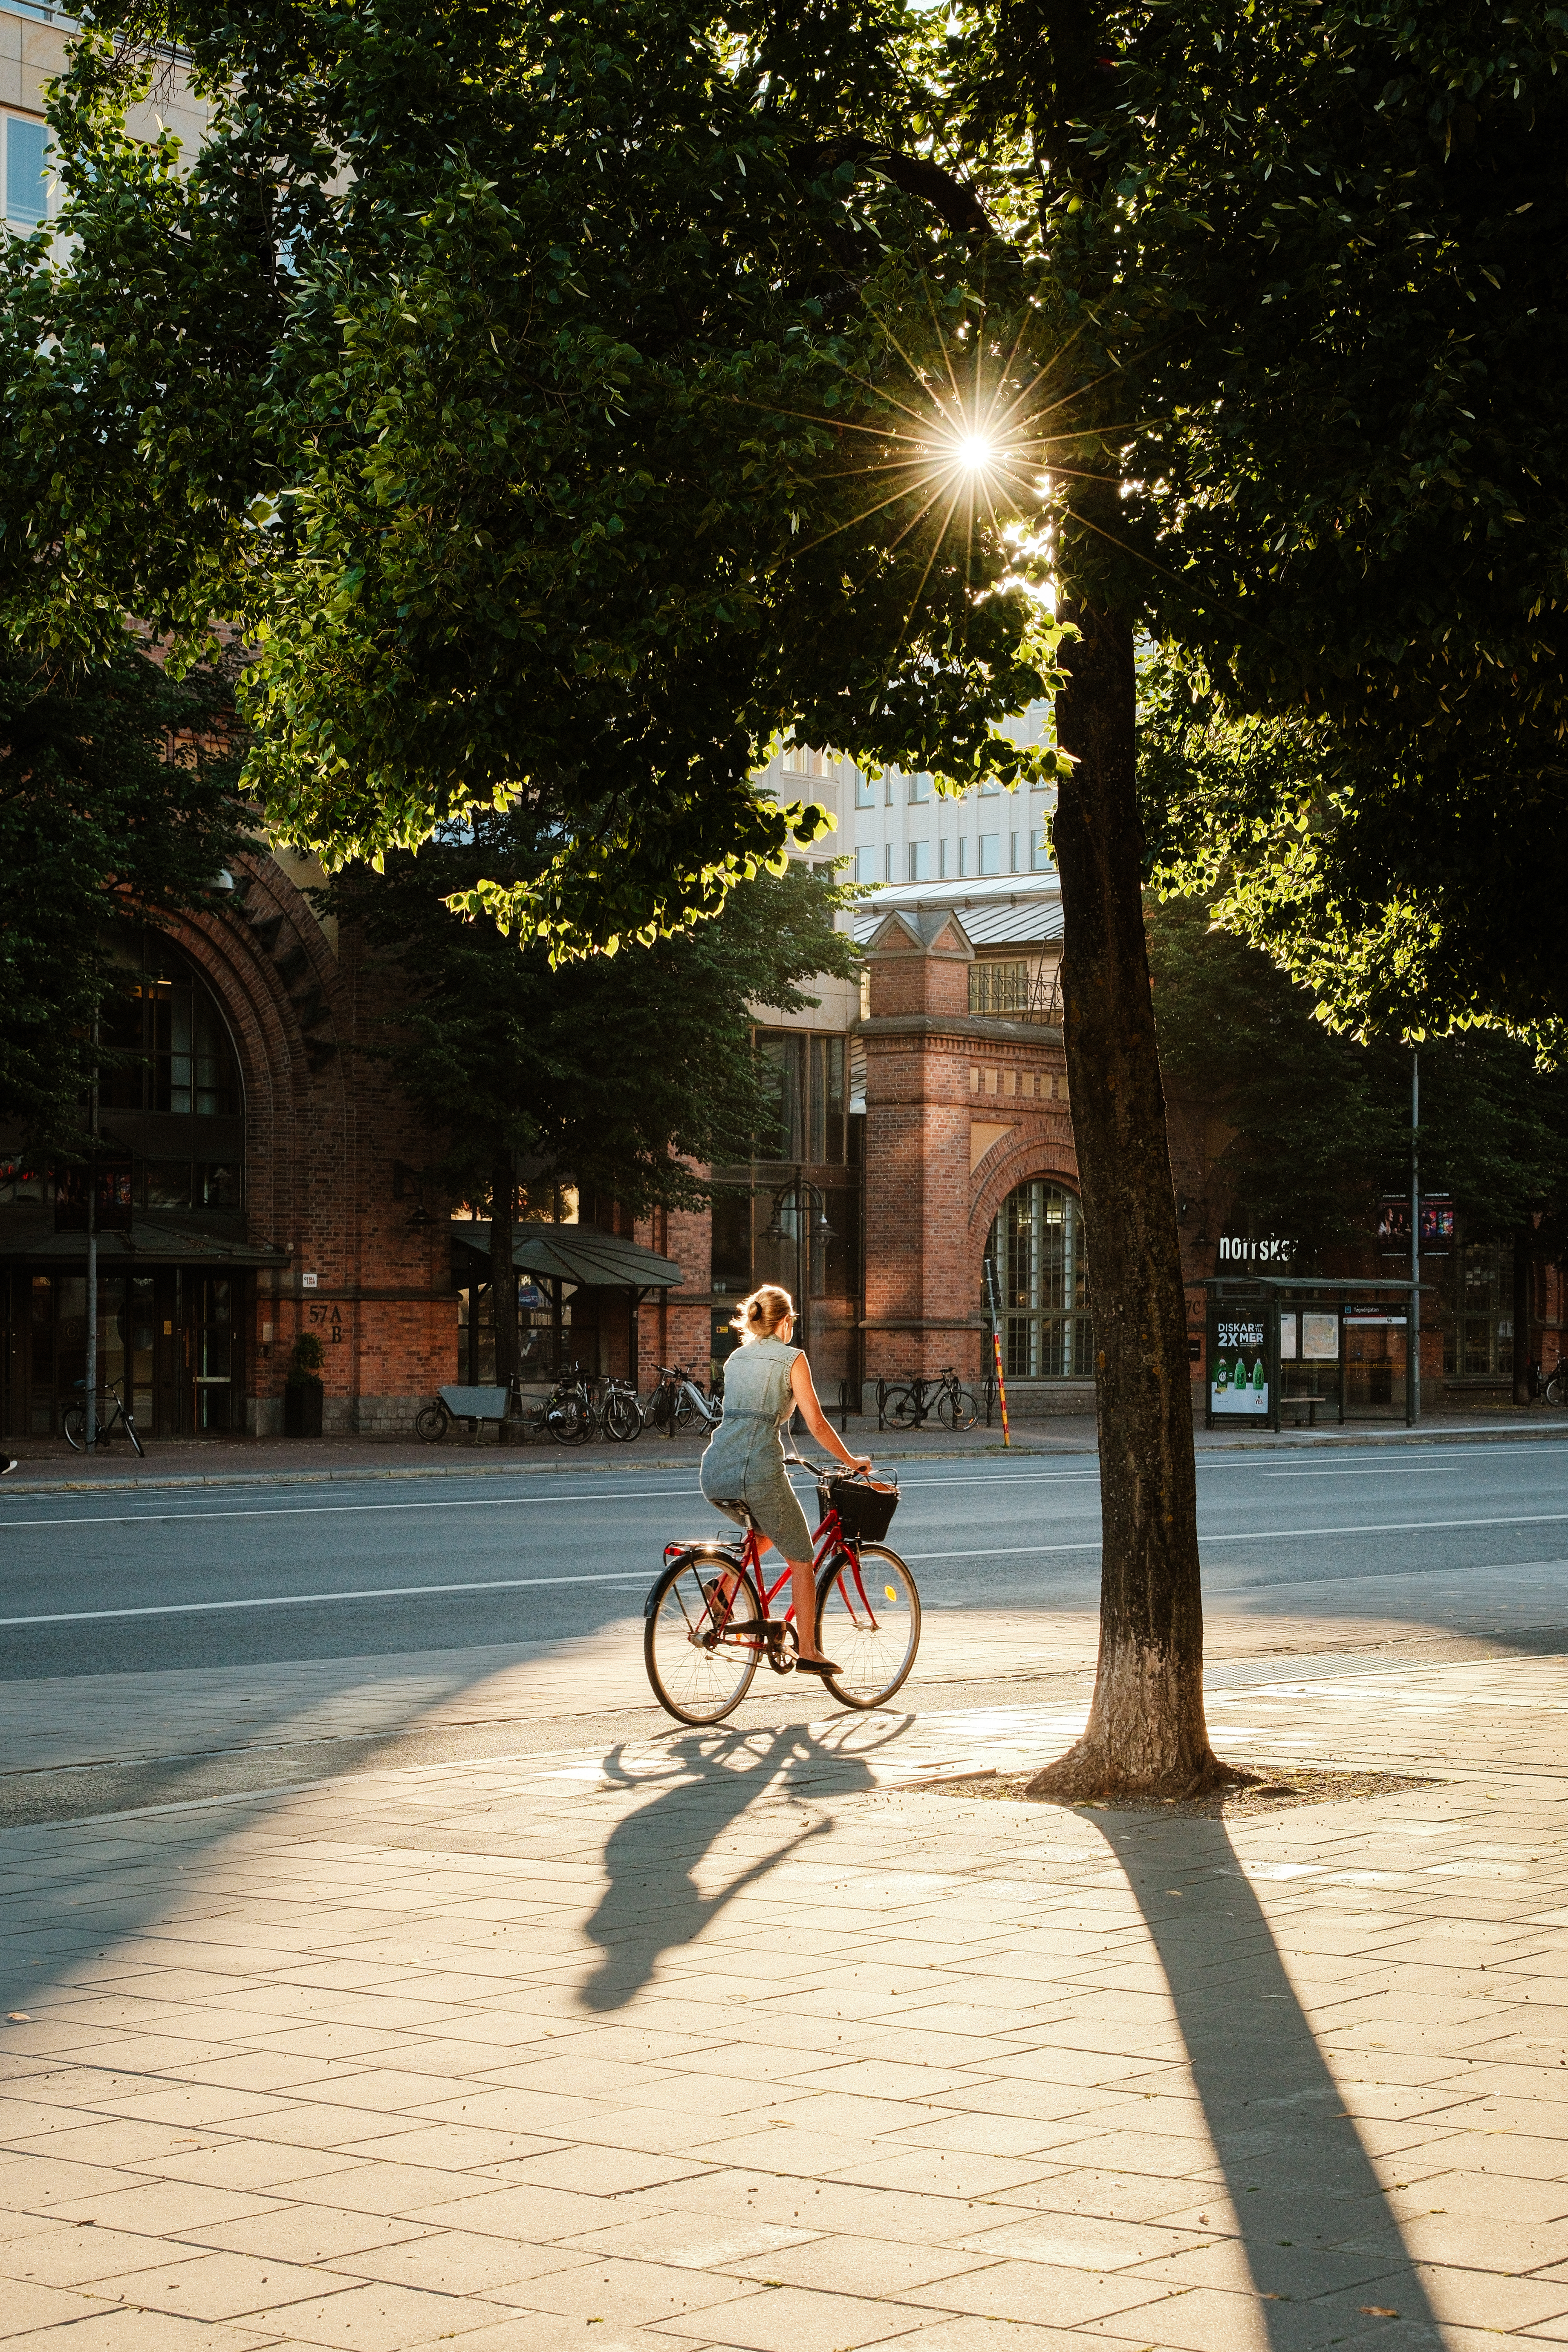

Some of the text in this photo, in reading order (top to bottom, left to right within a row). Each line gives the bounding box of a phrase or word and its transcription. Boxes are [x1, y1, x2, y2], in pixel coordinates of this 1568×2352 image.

[1218, 1323, 1254, 1332] DISKAR
[1218, 1332, 1263, 1347] 2X MER
